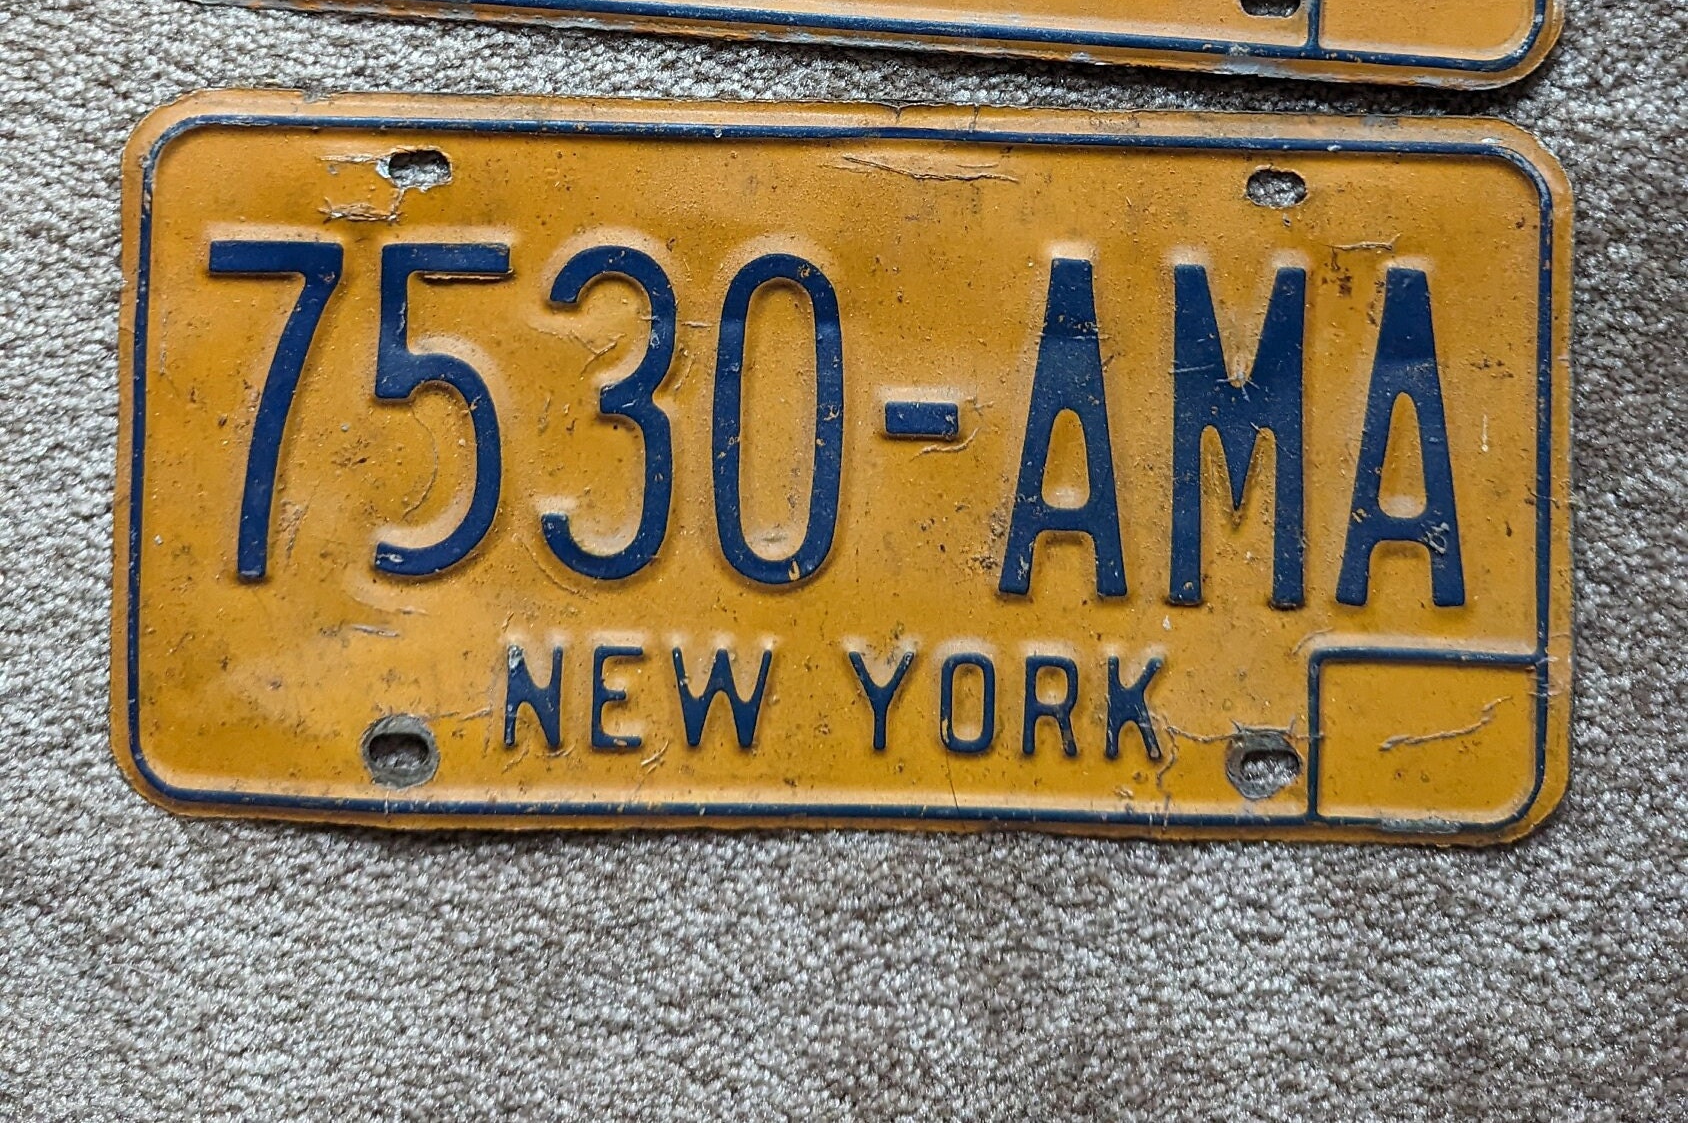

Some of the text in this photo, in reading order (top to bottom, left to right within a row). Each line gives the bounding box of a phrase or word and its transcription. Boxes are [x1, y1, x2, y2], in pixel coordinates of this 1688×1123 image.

[208, 239, 1466, 607] 7530-AMA
[504, 645, 1163, 760] NEW YORK
